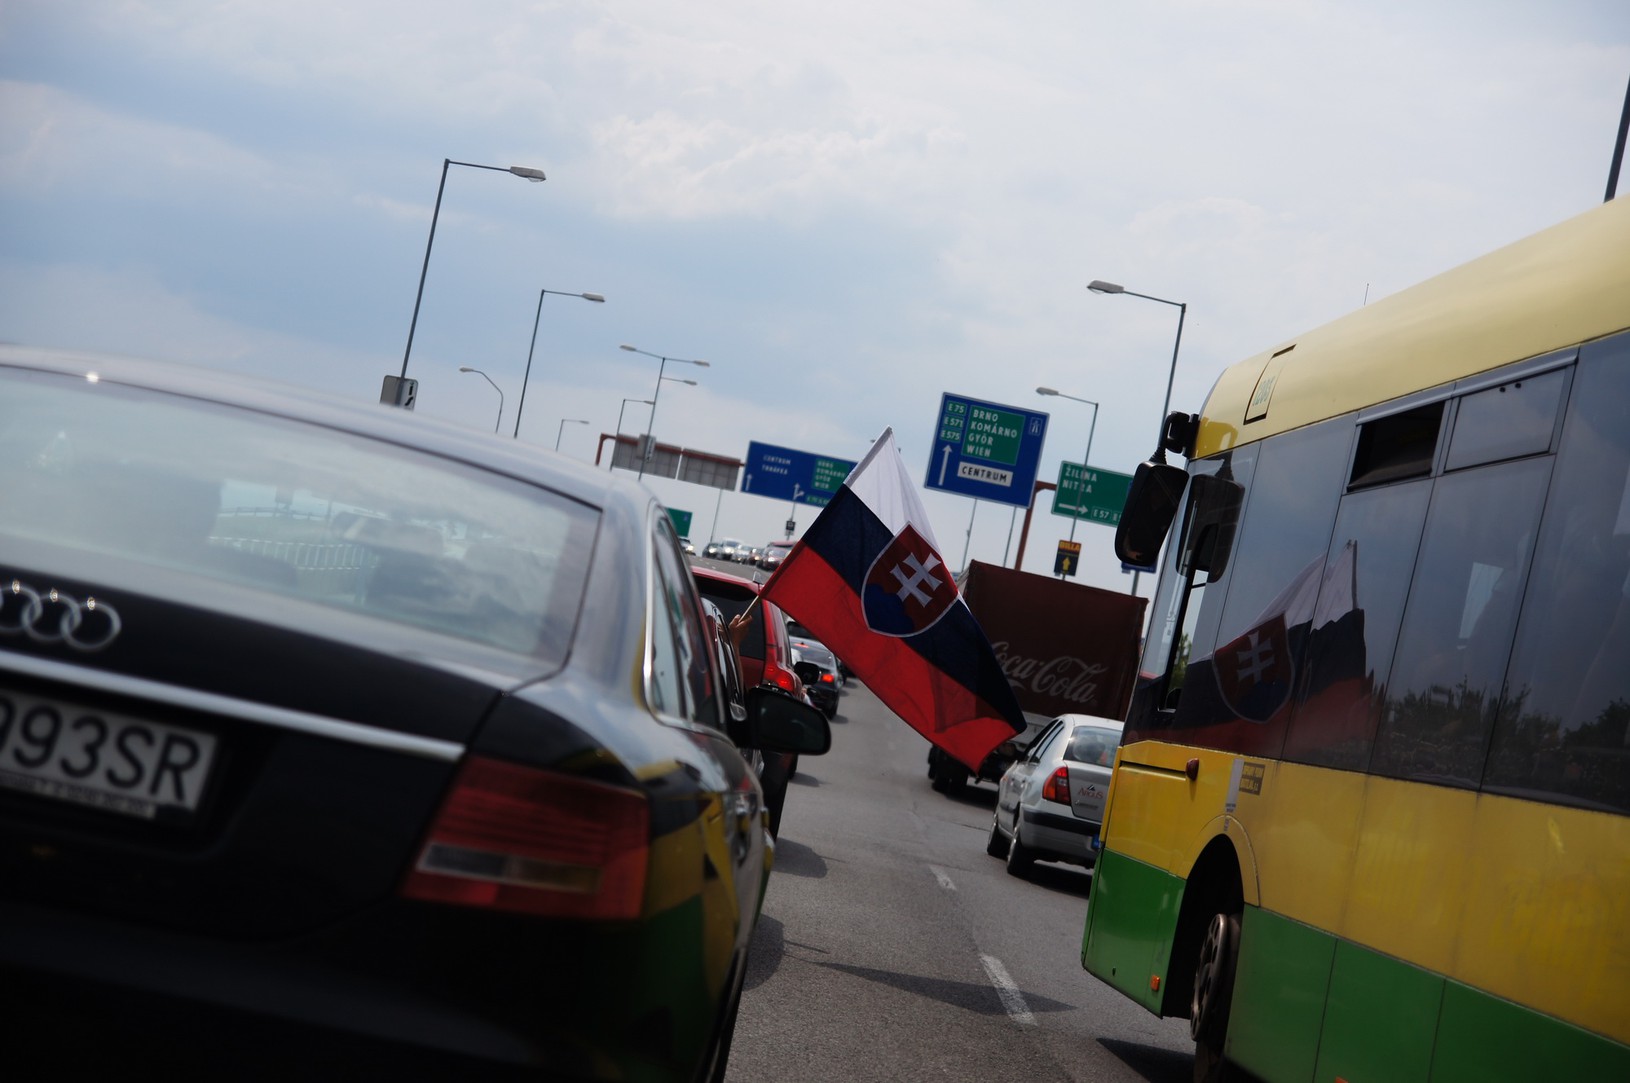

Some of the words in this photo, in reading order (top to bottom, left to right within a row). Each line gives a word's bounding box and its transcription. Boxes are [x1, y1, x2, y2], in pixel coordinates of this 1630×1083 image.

[947, 403, 954, 412] E
[955, 405, 965, 413] 75
[944, 416, 950, 425] E
[973, 409, 999, 422] BRNO
[946, 431, 960, 440] 575
[970, 420, 1018, 438] KOMÁRNO
[966, 445, 991, 458] WIEN
[763, 455, 791, 465] CENTRUM
[961, 466, 1008, 483] CENTRUM
[1065, 465, 1097, 482] ŽILINA
[1098, 510, 1110, 518] 57
[0, 700, 200, 801] 93SR
